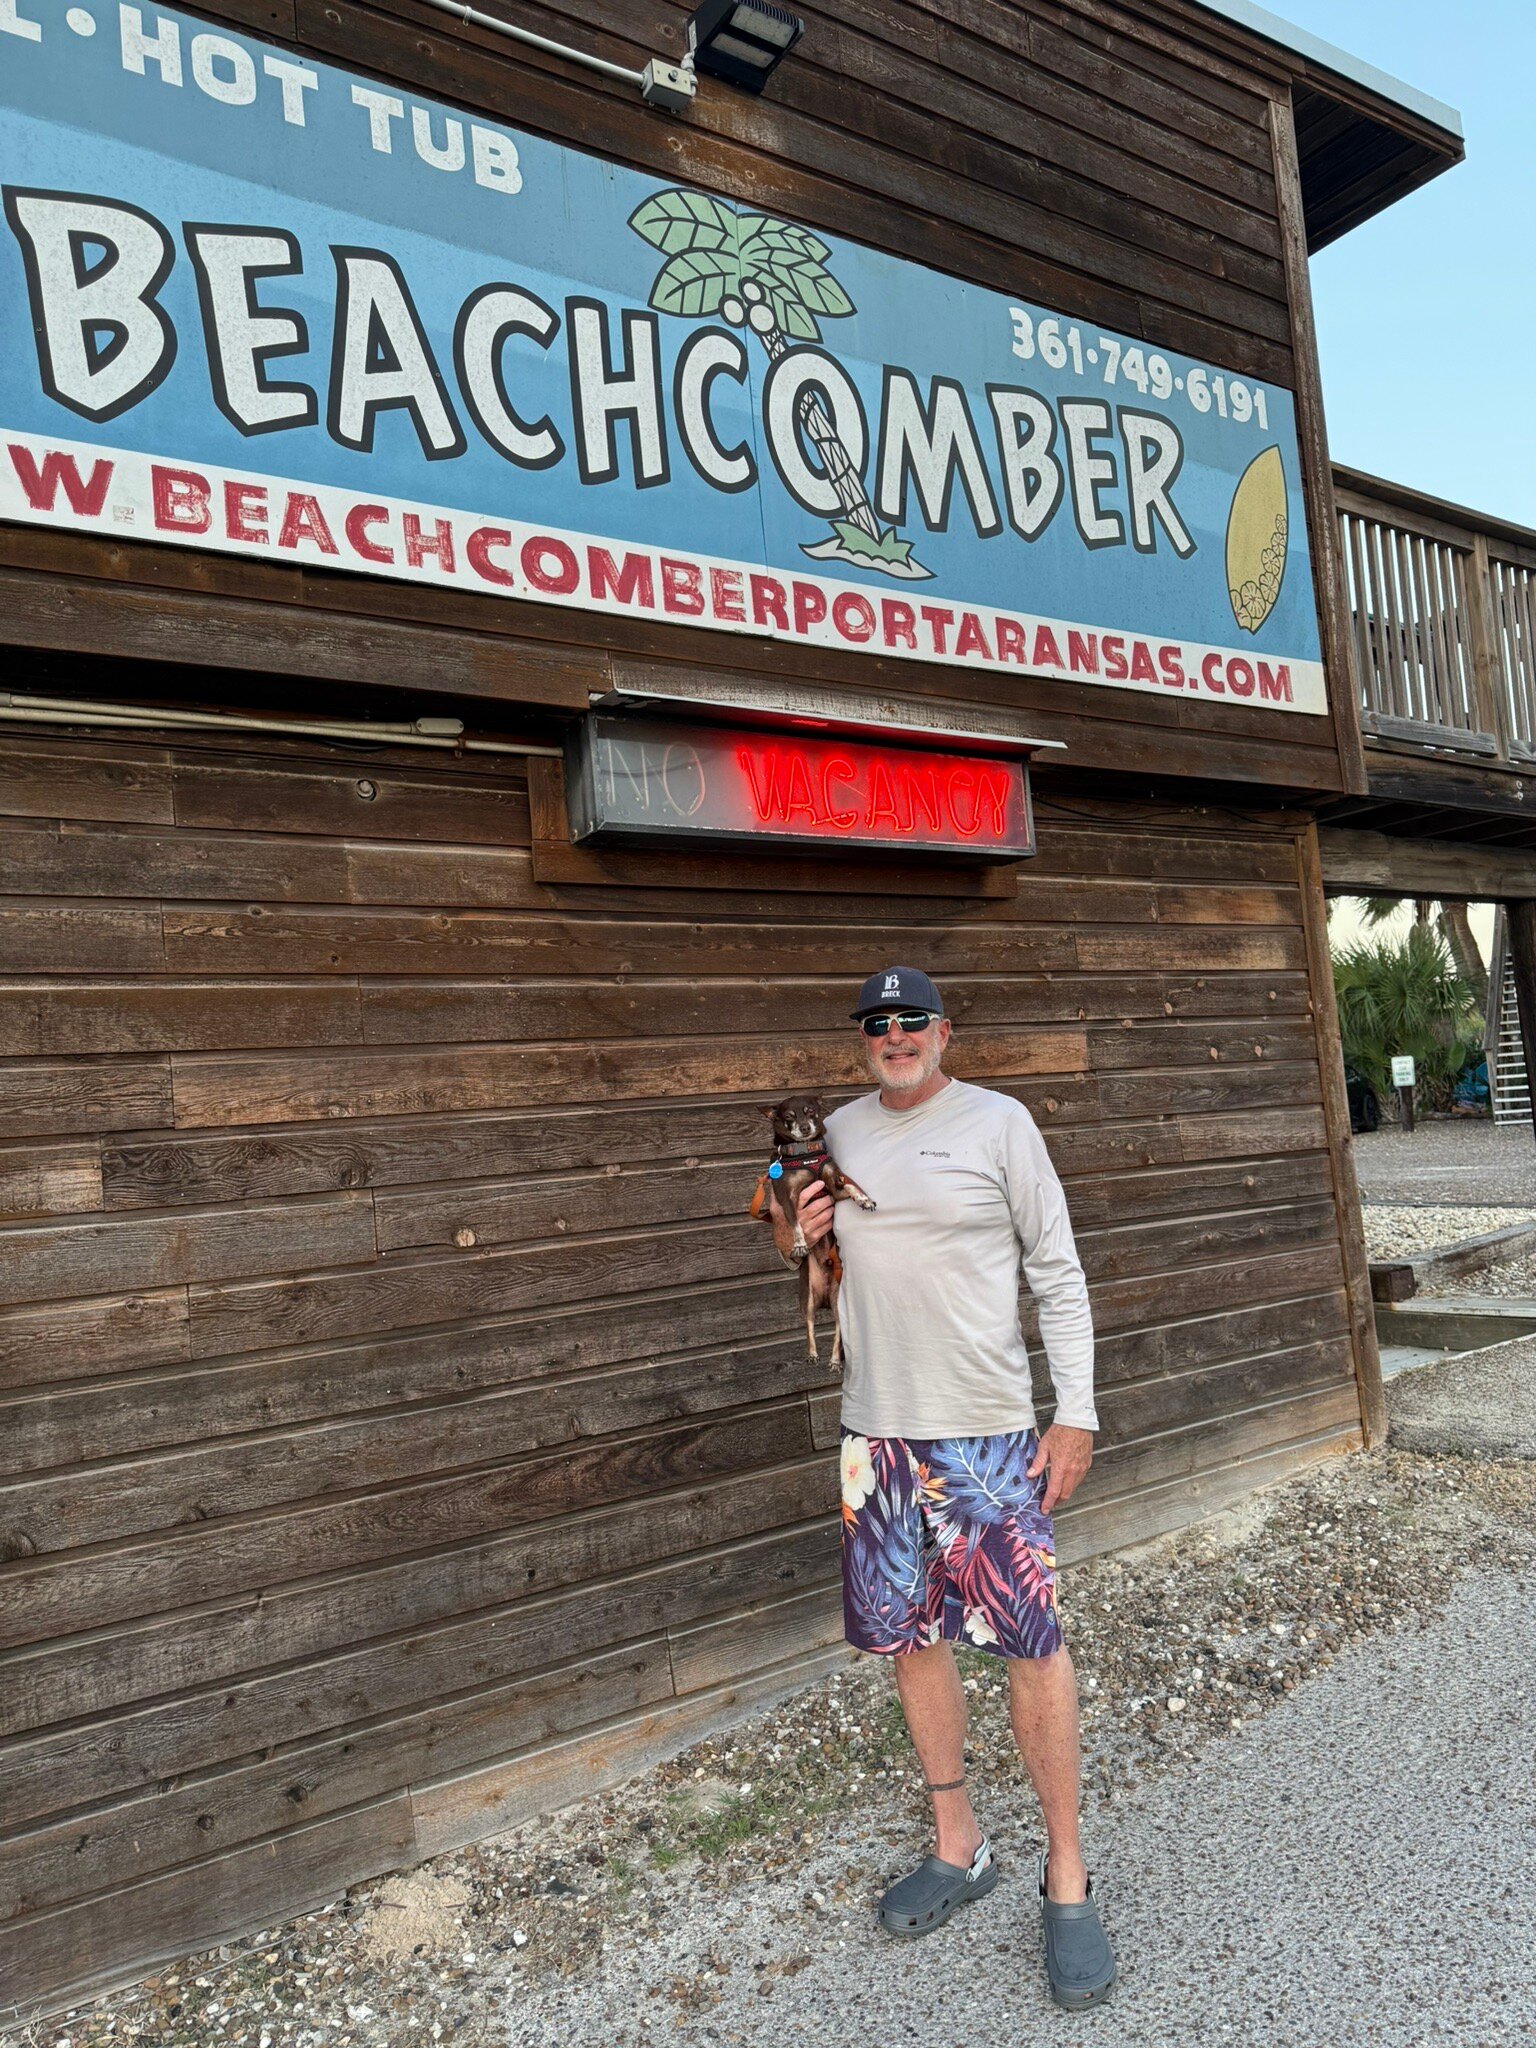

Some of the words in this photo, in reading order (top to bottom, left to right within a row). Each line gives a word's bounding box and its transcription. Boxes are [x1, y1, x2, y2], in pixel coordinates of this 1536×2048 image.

[119, 2, 319, 127] HOT
[351, 84, 524, 195] TUB
[1, 184, 1198, 560] BEACHCOMBER
[606, 741, 706, 816] NO
[736, 745, 1011, 836] VACANCY
